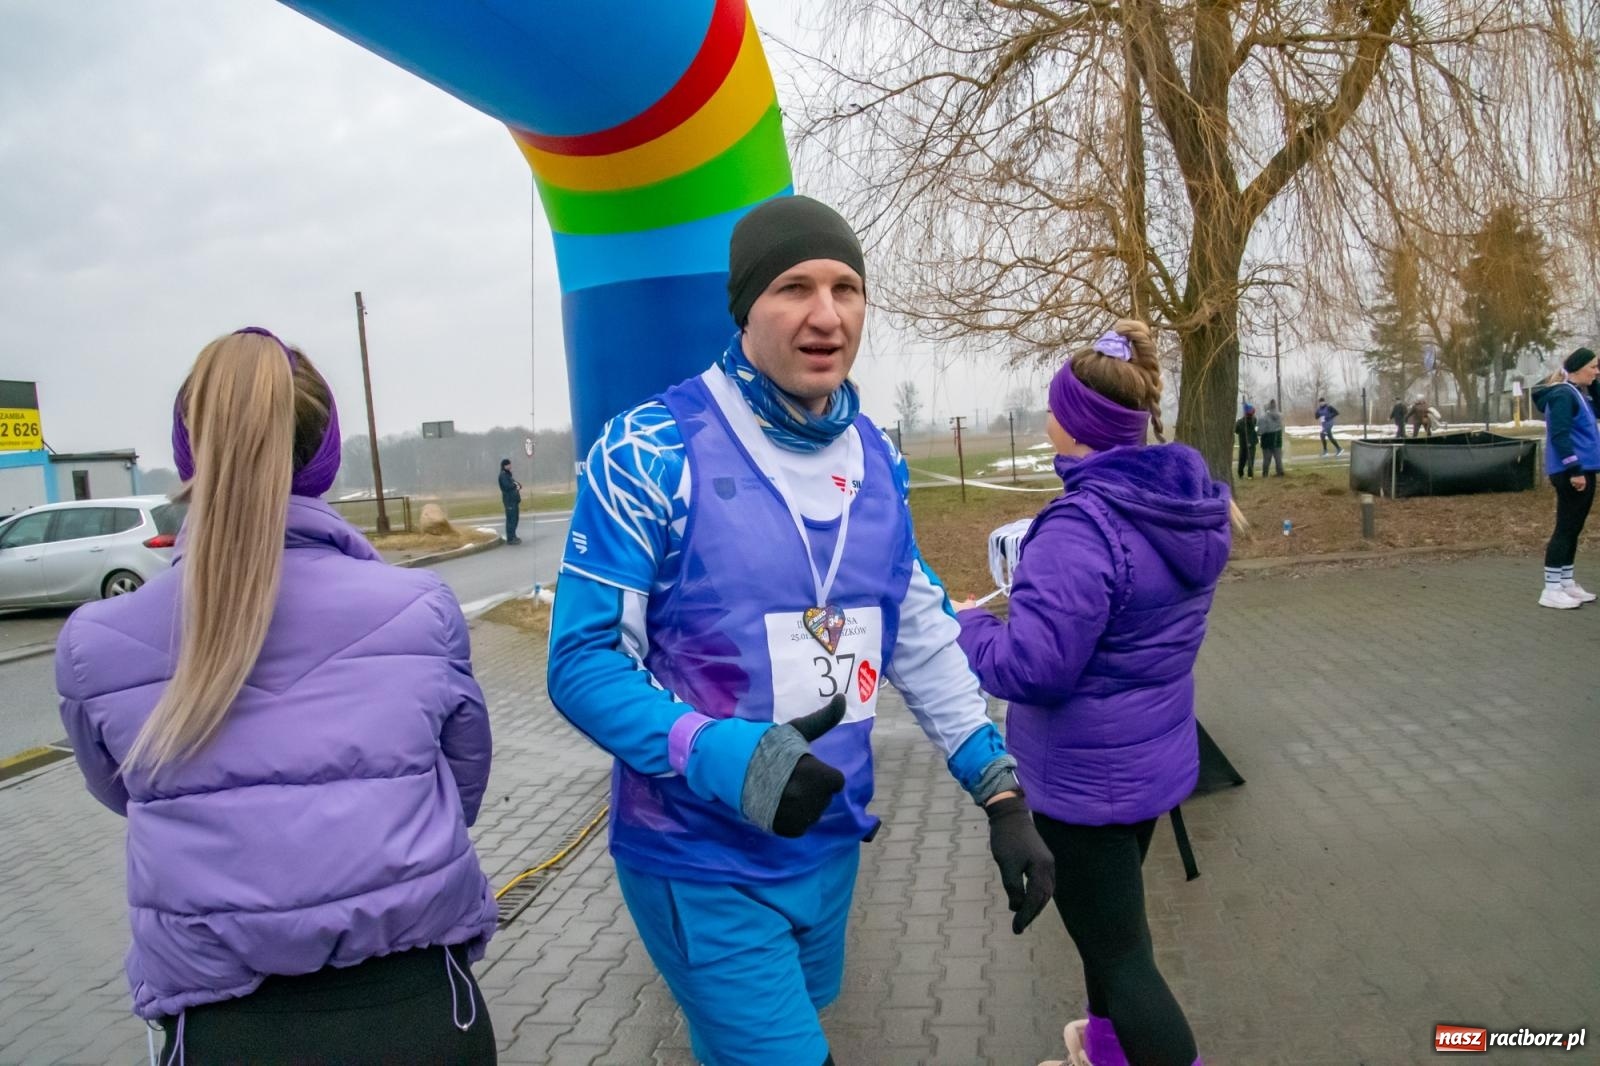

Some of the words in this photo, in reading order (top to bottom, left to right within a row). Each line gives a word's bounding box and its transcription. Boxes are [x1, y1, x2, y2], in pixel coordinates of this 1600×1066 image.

[0, 422, 9, 437] 2
[13, 422, 39, 437] 626
[813, 653, 855, 697] 37
